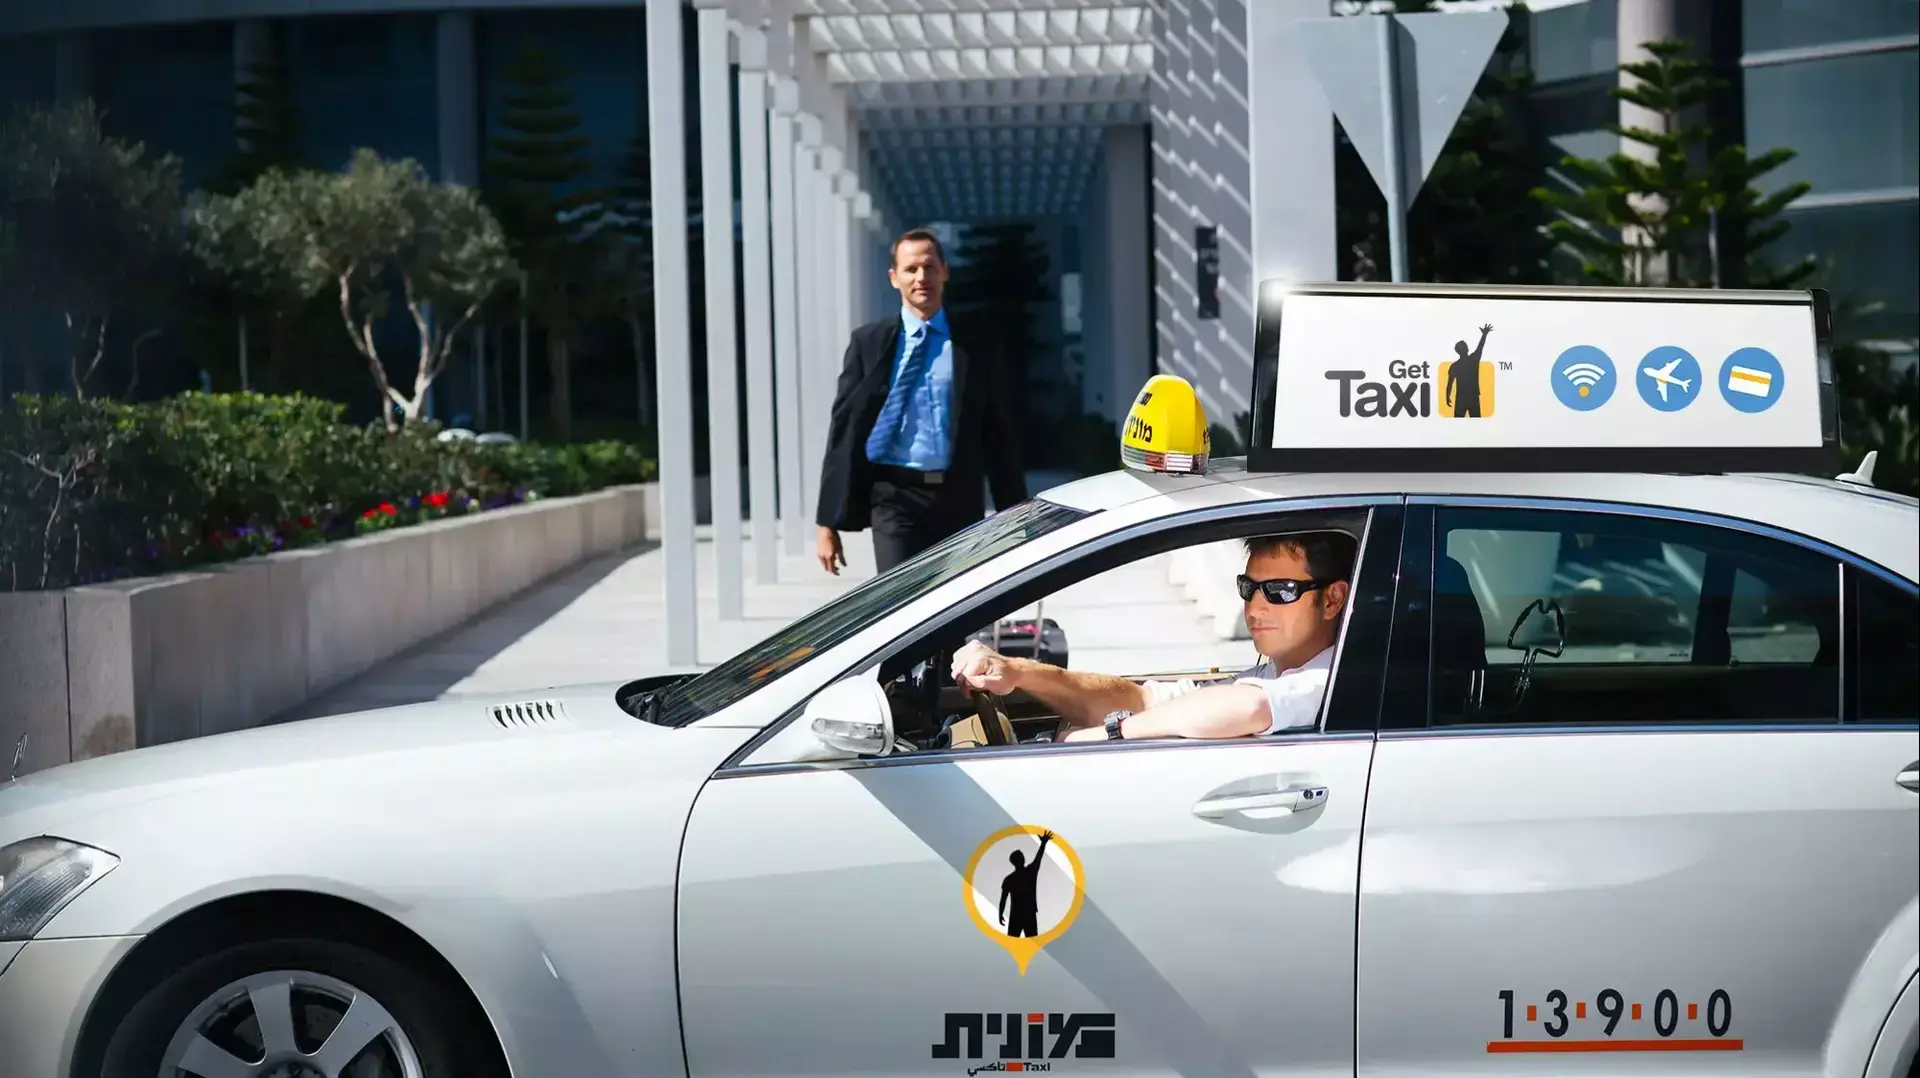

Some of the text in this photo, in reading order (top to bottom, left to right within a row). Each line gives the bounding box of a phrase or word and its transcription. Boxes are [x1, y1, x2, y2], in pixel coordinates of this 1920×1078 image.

[1388, 359, 1430, 379] Get
[1324, 370, 1431, 418] Taxi
[932, 1013, 1115, 1059] מונית
[1023, 1062, 1051, 1072] Taxi
